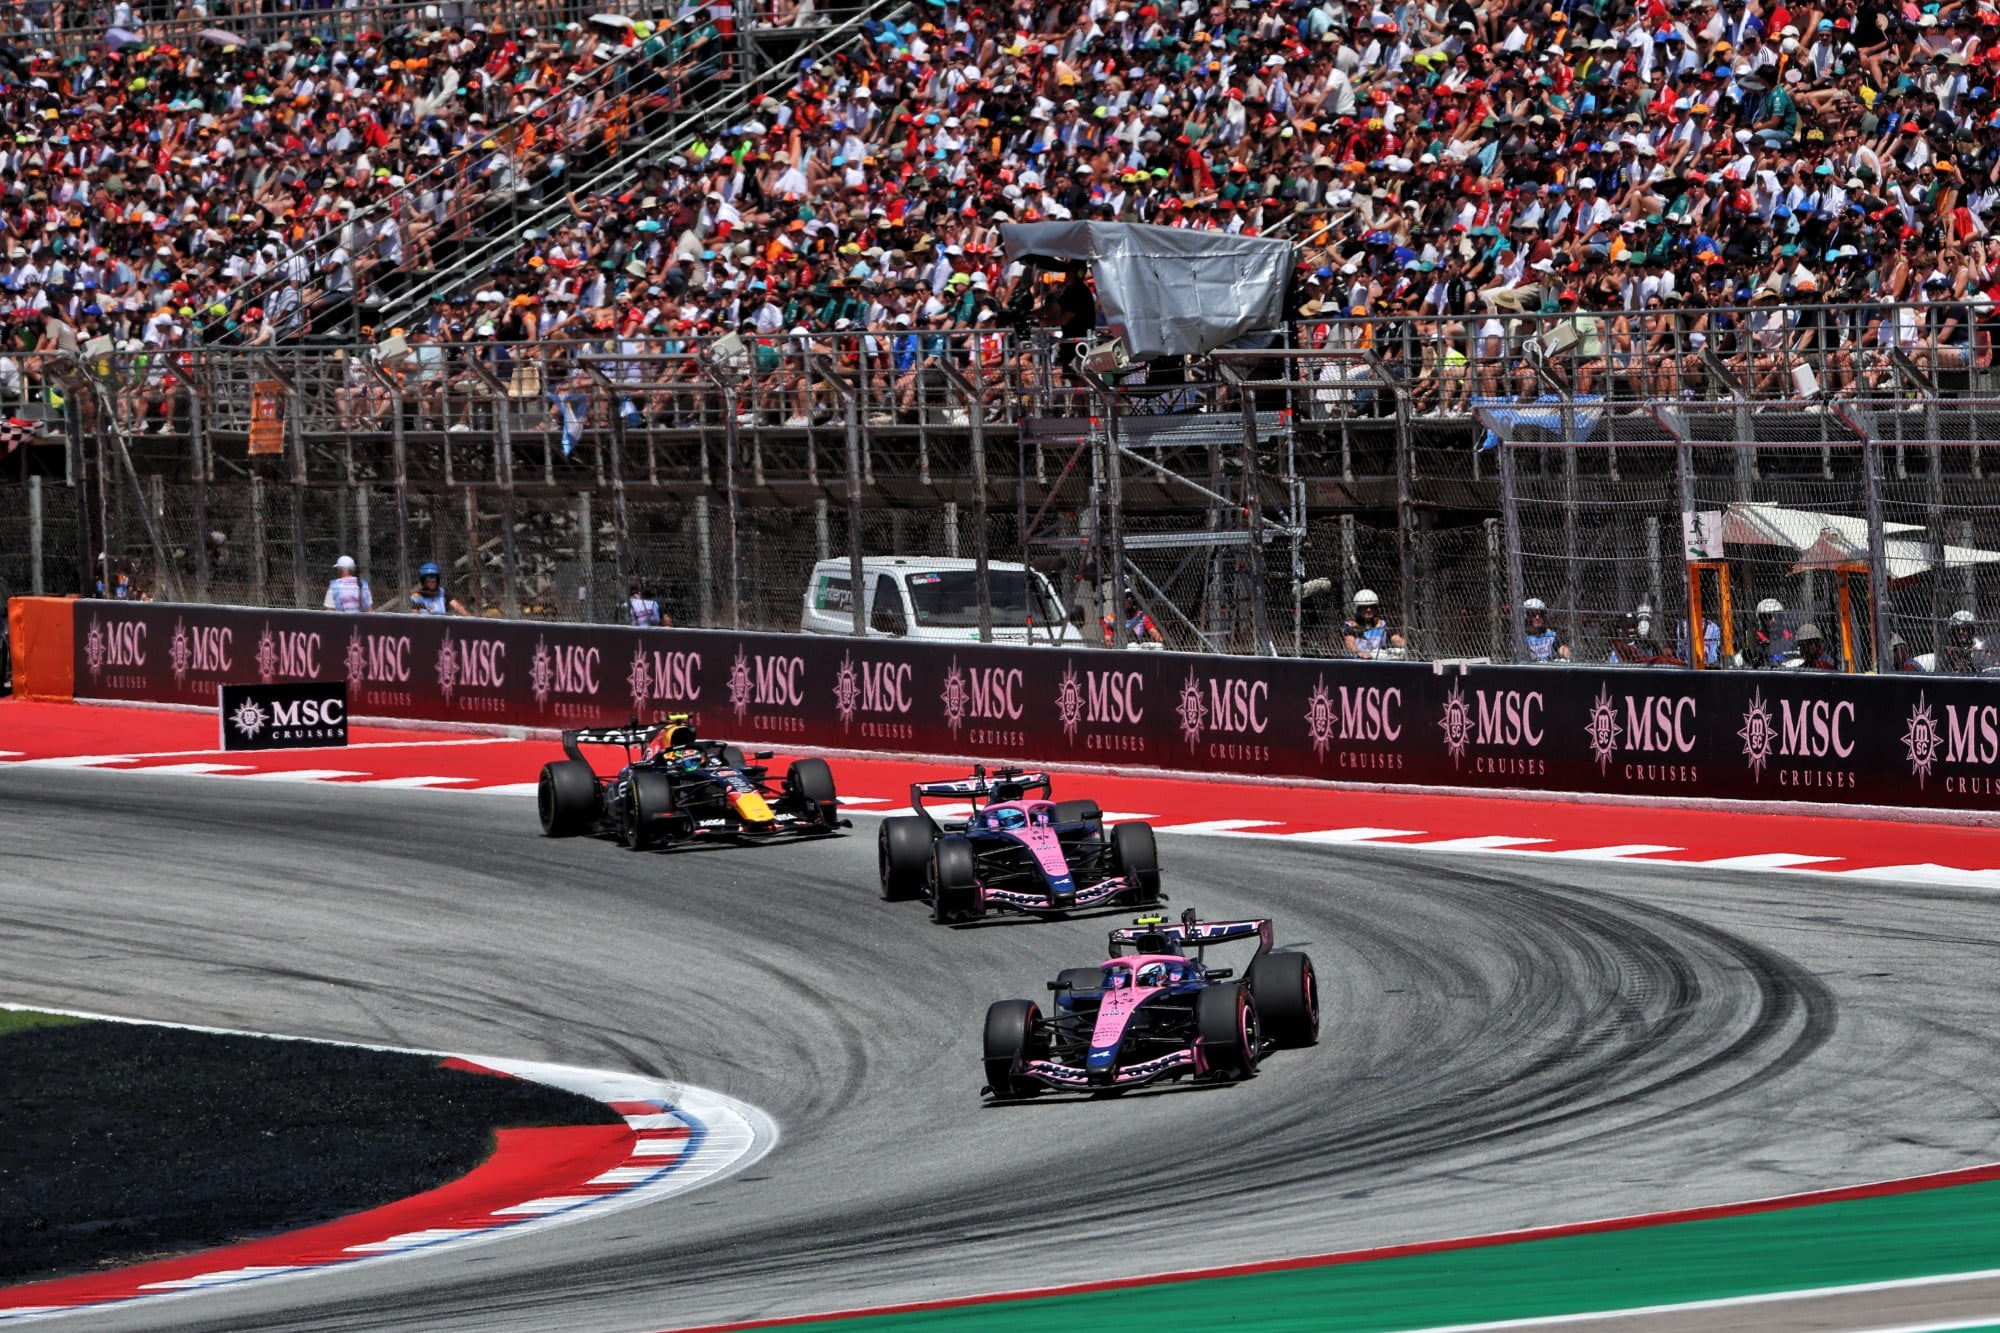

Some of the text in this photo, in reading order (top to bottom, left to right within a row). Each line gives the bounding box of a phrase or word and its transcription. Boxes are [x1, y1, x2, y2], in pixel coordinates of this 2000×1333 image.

[107, 621, 147, 666] MSC
[192, 627, 233, 671] MSC
[279, 632, 321, 678] MSC
[368, 636, 411, 682] MSC
[460, 640, 505, 687] MSC
[554, 645, 600, 694] MSC
[653, 651, 701, 701] MSC
[755, 656, 804, 707] MSC
[862, 662, 912, 713] MSC
[271, 699, 343, 726] MSC
[368, 691, 411, 706] CRUISES
[460, 697, 505, 712] CRUISES
[555, 703, 600, 719] CRUISES
[970, 668, 1023, 720] MSC
[1087, 671, 1143, 724] MSC
[1210, 679, 1268, 733] MSC
[1339, 686, 1402, 742] MSC
[272, 729, 344, 739] CRUISES
[754, 716, 805, 732] CRUISES
[861, 723, 913, 738] CRUISES
[970, 730, 1024, 746] CRUISES
[1476, 690, 1543, 747] MSC
[1625, 696, 1696, 753] MSC
[1780, 700, 1855, 758] MSC
[1946, 705, 1998, 764] MS
[1087, 734, 1145, 751] CRUISES
[1210, 743, 1269, 761] CRUISES
[1340, 752, 1403, 769] CRUISES
[1476, 757, 1544, 775] CRUISES
[1625, 764, 1697, 782] CRUISES
[1780, 770, 1855, 788] CRUISES
